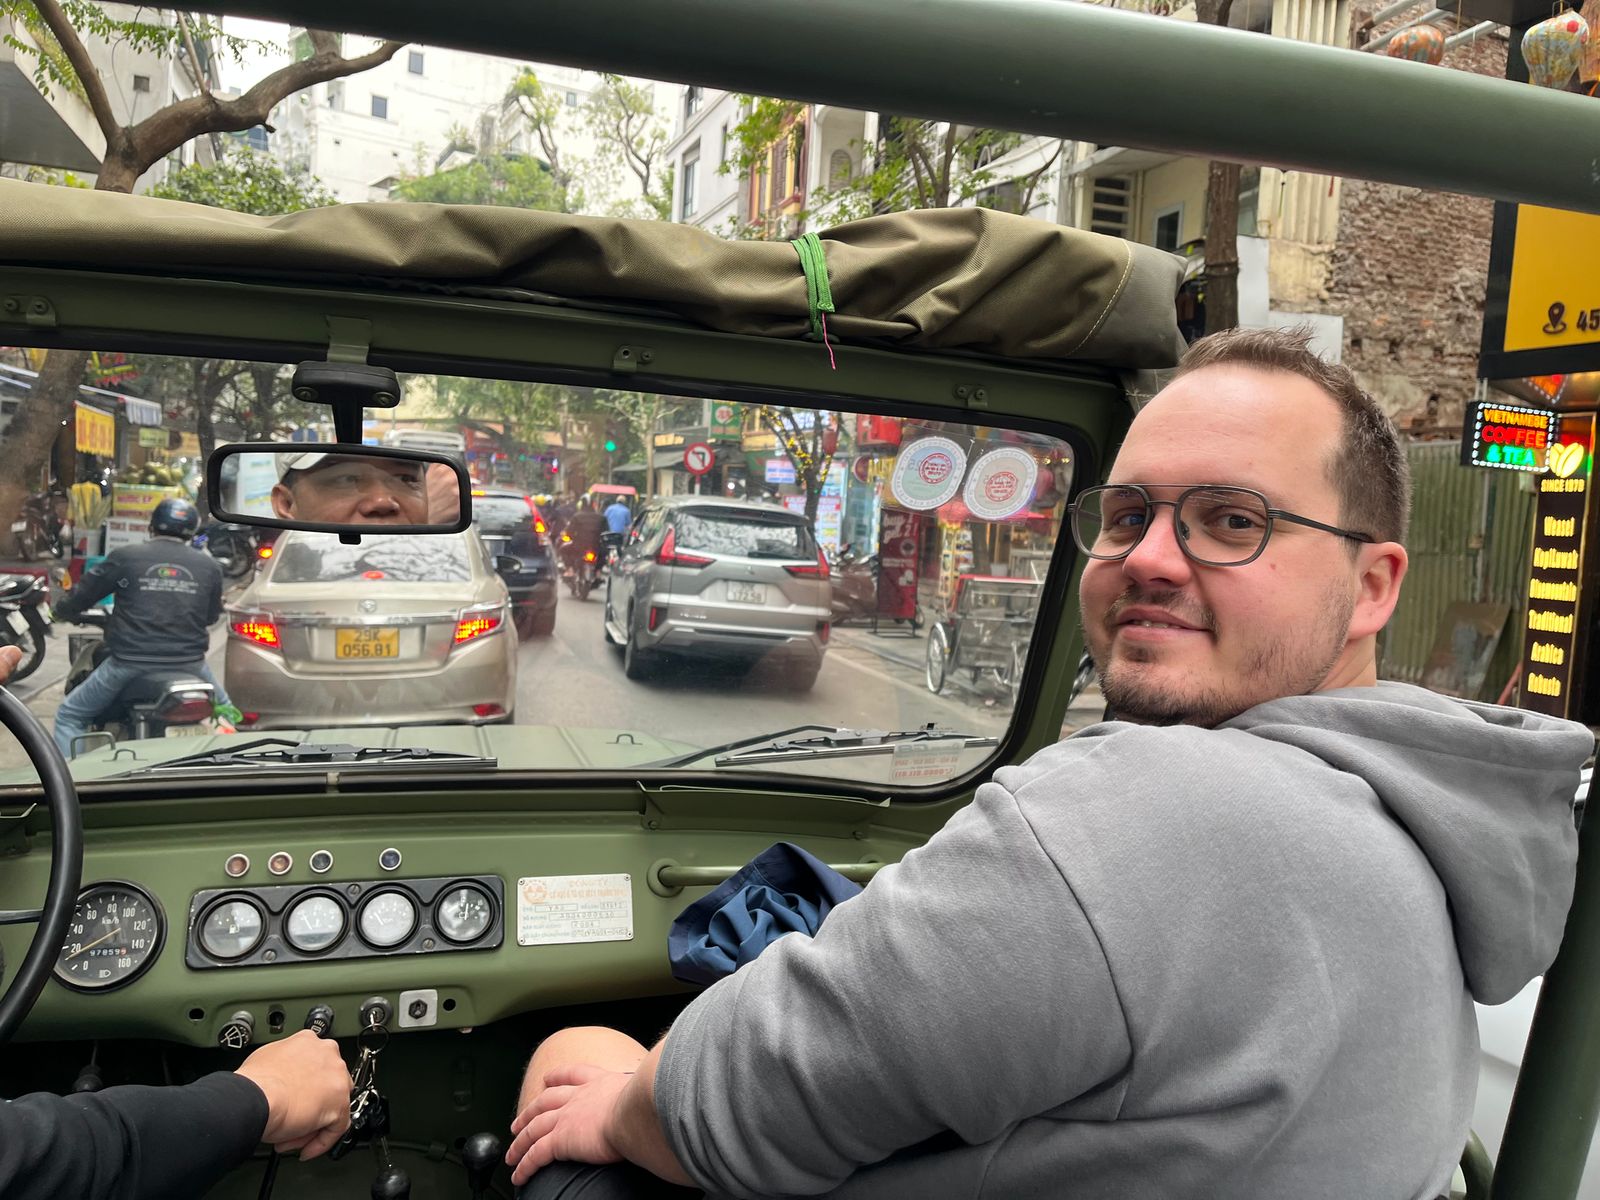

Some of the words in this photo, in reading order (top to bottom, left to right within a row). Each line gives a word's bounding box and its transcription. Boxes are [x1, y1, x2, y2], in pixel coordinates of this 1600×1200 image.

[1483, 408, 1548, 429] VIETNAMESE
[1482, 424, 1546, 449] COFFEE
[1486, 444, 1501, 463] &
[1503, 446, 1535, 467] TEA
[1541, 479, 1565, 492] SINCE
[107, 903, 117, 913] 80
[122, 908, 136, 918] 100
[86, 910, 97, 920] 60
[102, 916, 120, 925] km/h
[73, 924, 84, 935] 40
[134, 920, 147, 931] 120
[70, 943, 82, 954] 20
[131, 939, 145, 950] 140
[83, 961, 89, 971] 0
[118, 958, 132, 969] 160
